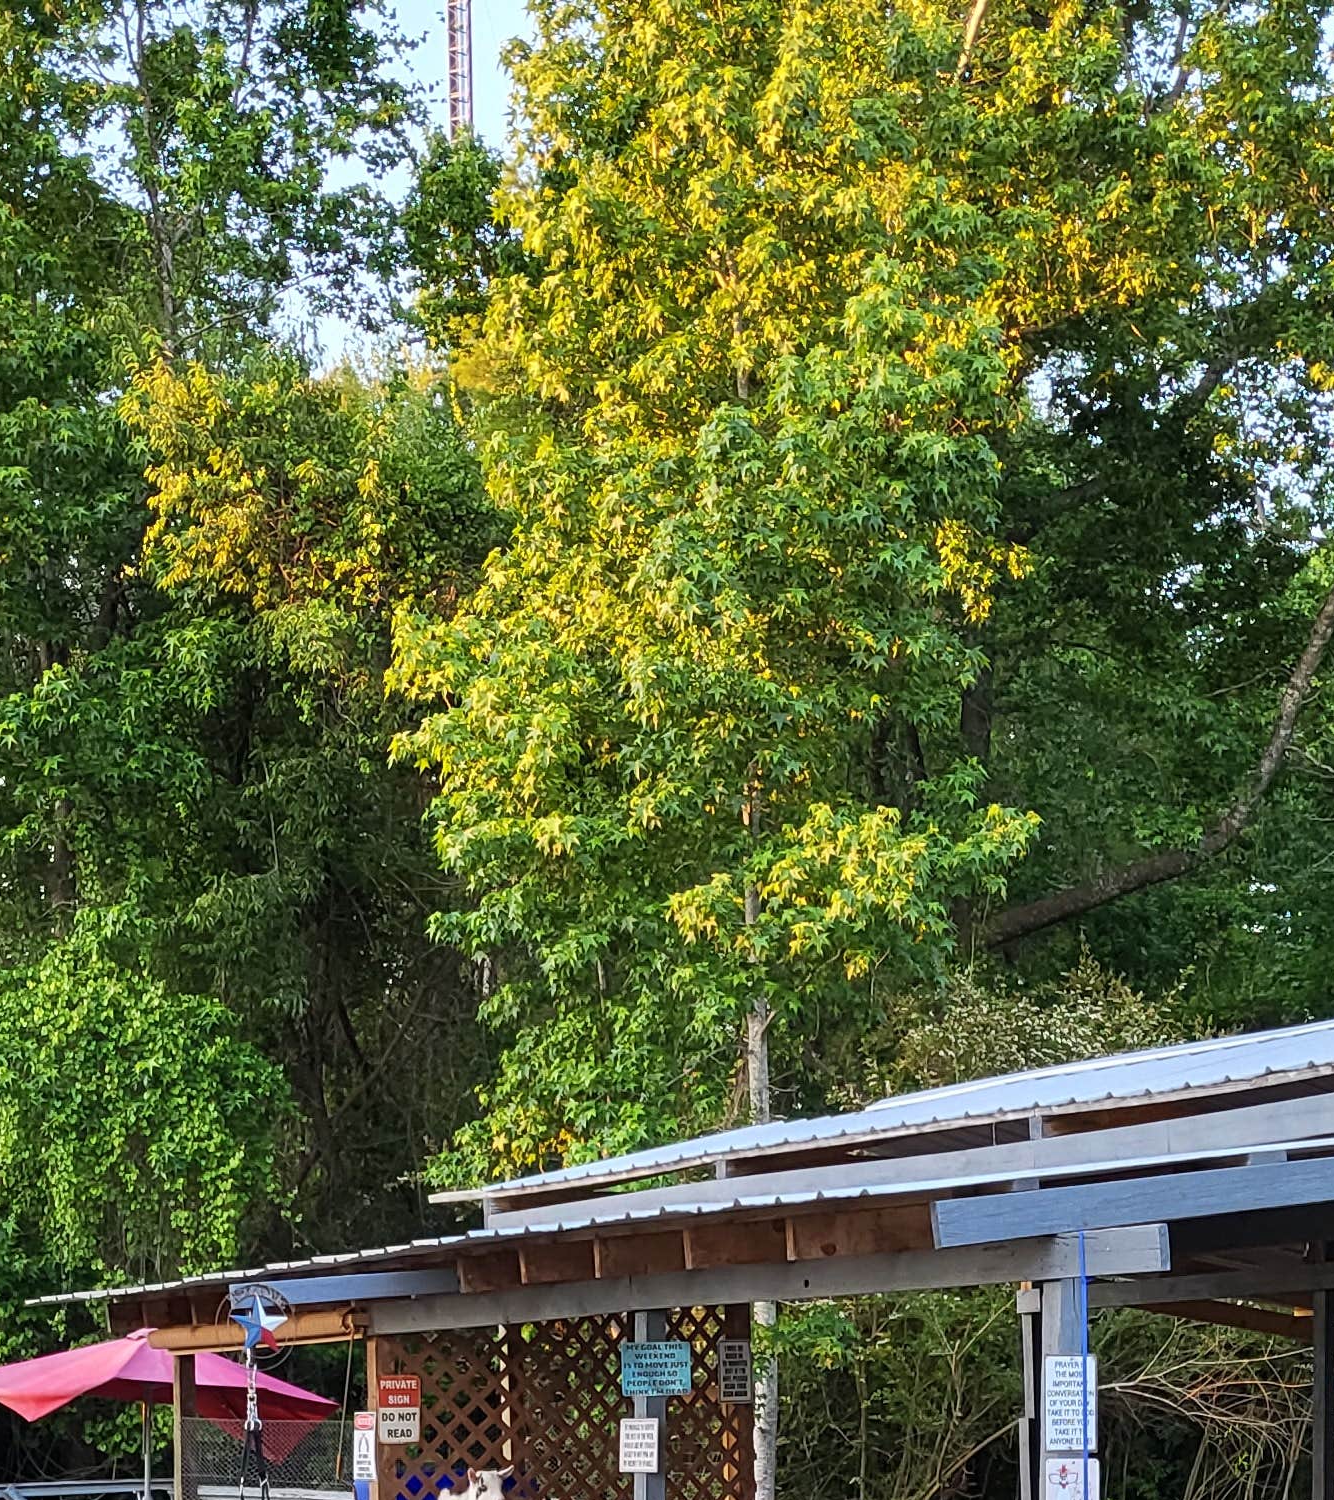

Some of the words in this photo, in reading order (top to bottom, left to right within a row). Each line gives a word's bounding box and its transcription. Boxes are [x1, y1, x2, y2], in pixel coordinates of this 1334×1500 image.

[1055, 1361, 1079, 1369] PRAYER
[380, 1380, 417, 1390] PRIVATE
[388, 1395, 410, 1405] SIGN
[382, 1413, 395, 1421] DO
[398, 1413, 417, 1422] NOT
[387, 1429, 412, 1438] READ
